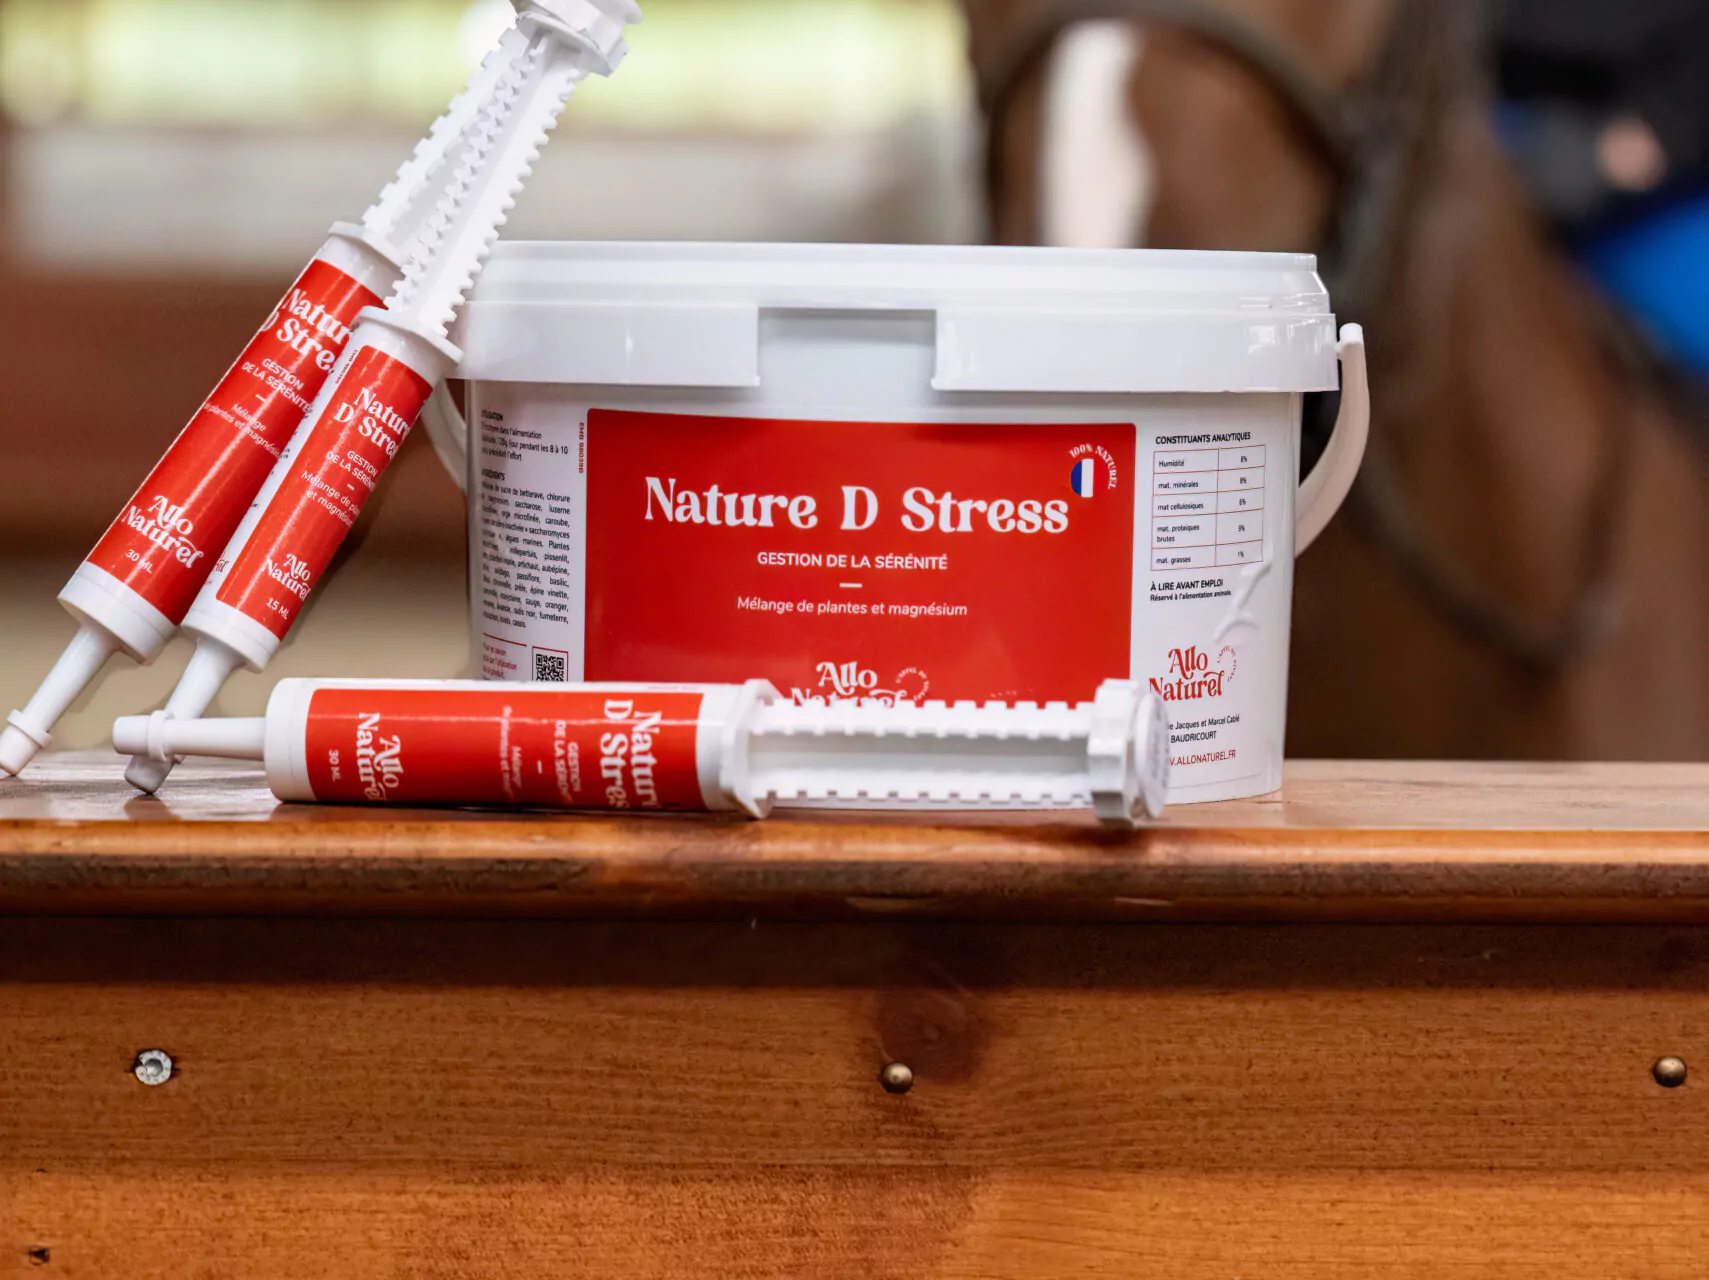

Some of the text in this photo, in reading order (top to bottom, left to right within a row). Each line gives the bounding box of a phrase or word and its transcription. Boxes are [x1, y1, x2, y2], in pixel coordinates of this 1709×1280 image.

[282, 288, 354, 345] Natur
[276, 319, 336, 373] Stre
[241, 362, 254, 373] DE
[253, 367, 266, 380] LA
[262, 358, 305, 391] GESTION
[333, 402, 400, 460] D Stres
[1155, 431, 1251, 445] CONSTITUANTS ANALYTIQUES
[519, 441, 540, 452] pendant
[540, 443, 549, 452] les
[549, 444, 554, 453] 8
[554, 445, 559, 453] à
[560, 446, 569, 455] 10
[325, 450, 340, 464] DE
[339, 458, 351, 472] LA
[346, 450, 379, 477] GESTION
[1069, 443, 1118, 490] 100% NATUREL
[1158, 459, 1185, 467] Humidité
[301, 470, 340, 500] Mélange
[340, 492, 351, 506] de
[1157, 481, 1172, 489] mat.
[1172, 480, 1199, 489] minérales
[306, 489, 318, 500] et
[512, 487, 519, 495] de
[519, 488, 545, 500] betterave,
[546, 492, 571, 503] chlorure
[514, 500, 571, 515] saccharose, luzerne
[644, 476, 1069, 533] Nature D Stress
[1170, 502, 1204, 511] cellulosiques
[148, 495, 194, 535] Allo
[544, 517, 570, 527] caroube,
[121, 505, 204, 569] Naturel
[528, 526, 571, 539] saccharomyces
[1156, 535, 1175, 543] brutes
[548, 540, 570, 551] Plantes
[125, 549, 140, 562] 30
[544, 553, 570, 564] pissenlit,
[757, 551, 948, 570] GESTION DE LA SÉRÉNITÉ
[1170, 557, 1192, 565] grasses
[282, 553, 311, 581] Allo
[541, 564, 570, 576] aubépine,
[549, 576, 570, 588] basilic,
[1150, 578, 1223, 591] À LIRE AVANT EMPLOI
[529, 585, 545, 597] épine
[547, 588, 570, 600] vinette,
[1150, 593, 1174, 601] Réservé
[1179, 591, 1213, 600] l'alimentation
[265, 597, 280, 611] 15
[545, 601, 569, 612] oranger,
[737, 597, 968, 618] Mélange de plantes et magnésium
[539, 611, 569, 624] fumeterre,
[1167, 645, 1209, 680] Allo
[815, 661, 878, 696] Allo
[1148, 671, 1225, 701] Naturel
[603, 699, 634, 720] D
[1174, 721, 1200, 730] Jacques
[1200, 719, 1207, 728] et
[1207, 716, 1226, 726] Marcel
[1170, 731, 1217, 743] BAUDRICOURT
[328, 749, 340, 765] 30
[373, 734, 404, 788] Allo
[631, 711, 662, 808] Natur
